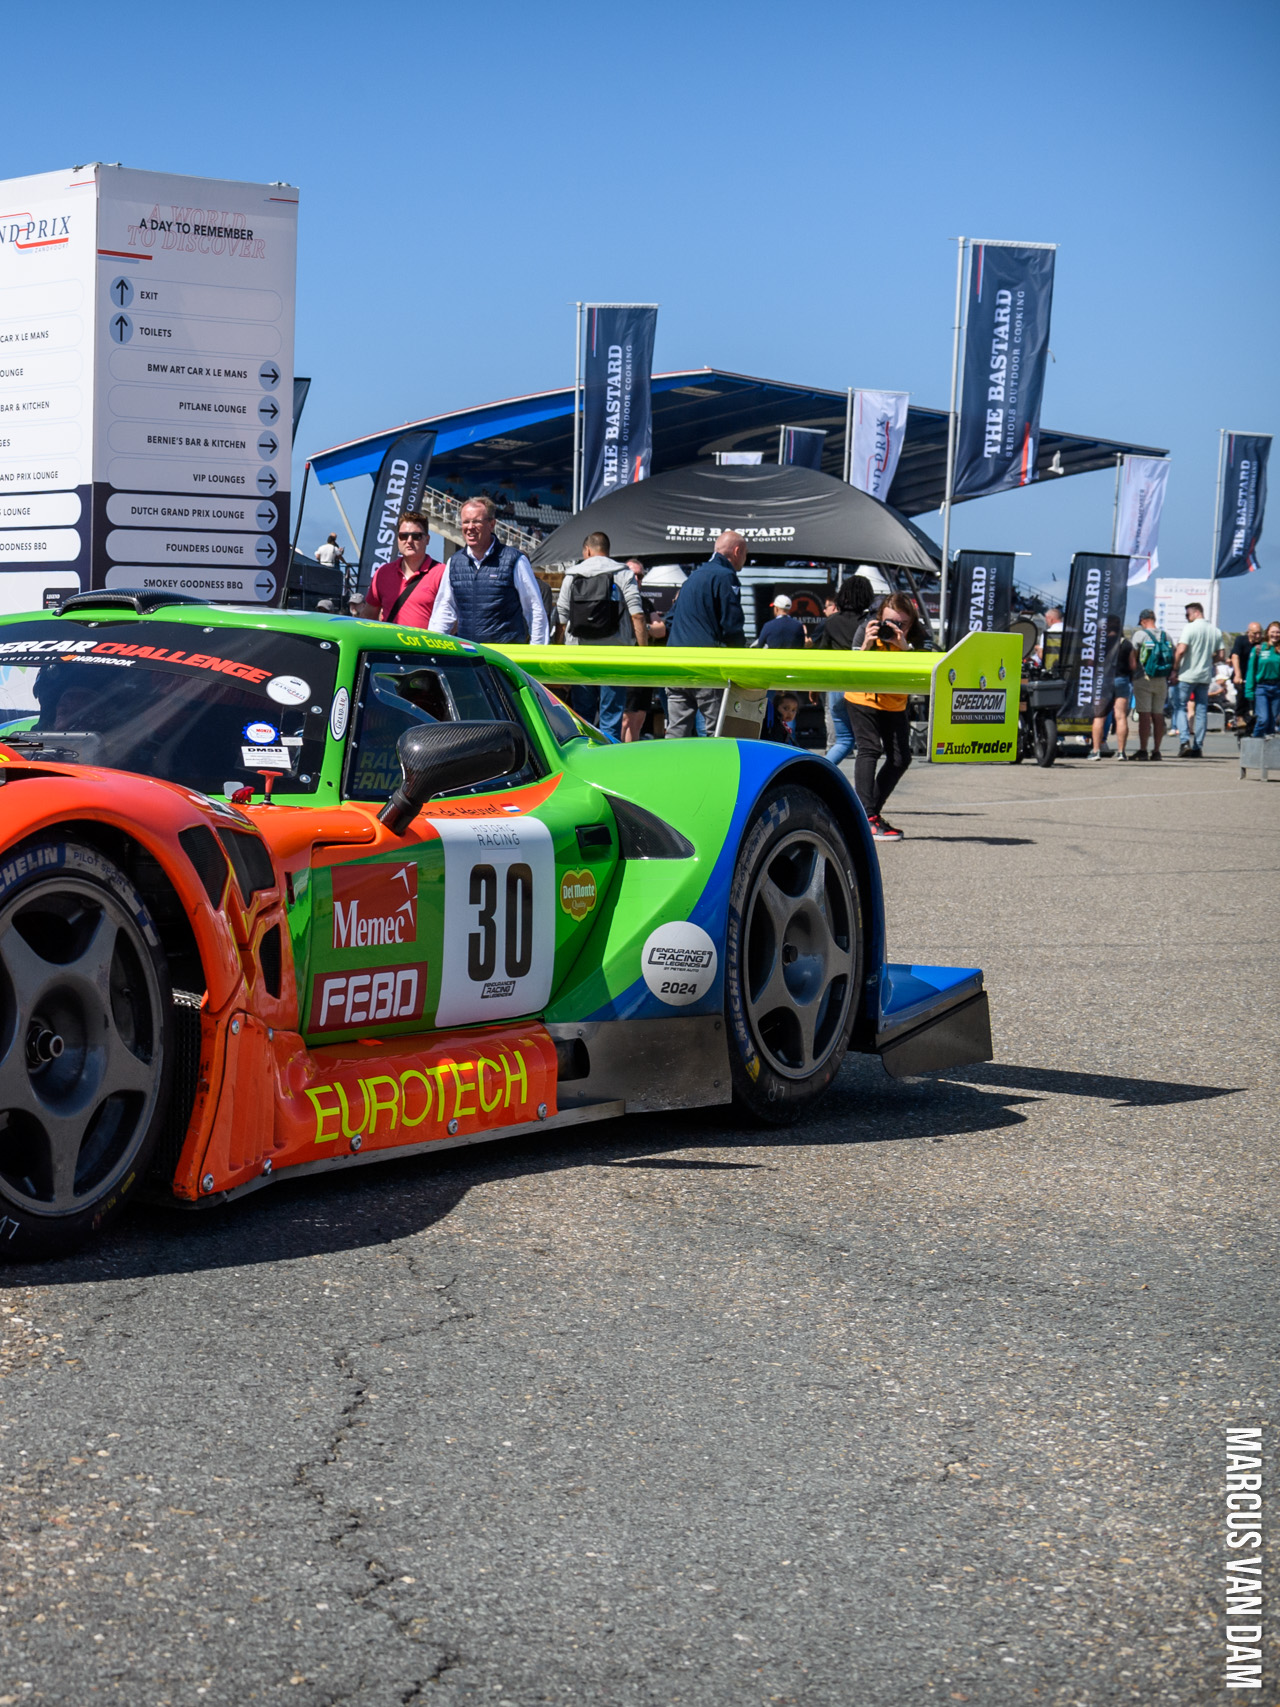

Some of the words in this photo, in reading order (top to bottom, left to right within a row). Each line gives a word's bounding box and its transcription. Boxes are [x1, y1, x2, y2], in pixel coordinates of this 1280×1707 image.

[25, 215, 71, 240] PRIX
[140, 218, 148, 230] A
[150, 219, 173, 232] DAY
[176, 222, 191, 234] TO
[193, 224, 254, 241] REMEMBER
[171, 206, 246, 230] WORLD
[161, 229, 266, 259] DISCOVER
[140, 290, 159, 301] EXIT
[1014, 291, 1026, 343] COOKING
[0, 334, 14, 344] CAR
[20, 332, 29, 342] LE
[29, 330, 49, 341] MANS
[139, 326, 172, 338] TOILETS
[988, 289, 1012, 401] BASTARD
[147, 363, 169, 374] BMW
[169, 365, 186, 375] ART
[186, 366, 204, 377] CAR
[212, 368, 222, 378] LE
[222, 369, 248, 379] MANS
[625, 345, 633, 391] COOKING
[1010, 348, 1020, 403] OUTDOOR
[606, 345, 622, 440] BASTARD
[0, 403, 14, 413] BAR
[22, 400, 50, 411] KITCHEN
[178, 401, 212, 413] PITLANE
[213, 404, 247, 414] LOUNGE
[623, 395, 631, 441] OUTDOOR
[185, 437, 202, 448] BAR
[211, 439, 246, 450] KITCHEN
[874, 419, 886, 462] PRIX
[984, 409, 1004, 458] THE
[1006, 409, 1017, 458] SERIOUS
[16, 472, 32, 482] PRIX
[32, 470, 59, 481] LOUNGE
[604, 444, 618, 486] THE
[621, 445, 629, 485] SERIOUS
[192, 473, 207, 483] VIP
[208, 474, 246, 485] LOUNGES
[406, 463, 422, 512] OOKING
[1235, 460, 1251, 526] BASTARD
[3, 507, 31, 517] LOUNGE
[130, 506, 159, 517] DUTCH
[160, 507, 190, 518] GRAND
[191, 508, 211, 519] PRIX
[212, 509, 245, 520] LOUNGE
[371, 459, 409, 578] BASTARD
[666, 525, 705, 536] THE
[33, 541, 47, 552] BBQ
[165, 543, 210, 554] FOUNDERS
[211, 544, 244, 555] LOUNGE
[1233, 529, 1245, 558] THE
[142, 578, 179, 589] SMOKEY
[179, 579, 225, 590] GOODNESS
[226, 580, 244, 591] BBQ
[1102, 570, 1111, 613] COOKING
[969, 566, 987, 632] STARD
[1081, 568, 1101, 661] BASTARD
[397, 633, 422, 646] Cor
[421, 635, 458, 651] Euser
[1099, 617, 1108, 663] OUTDOOR
[91, 641, 273, 684] CHALLENGE
[1078, 666, 1094, 707] THE
[954, 694, 1004, 711] SPEEDCOM
[951, 714, 1005, 722] COMMUNICATIONS
[943, 740, 1013, 755] AutoTrader
[471, 824, 515, 832] HISTORIC
[477, 834, 520, 846] RACING
[73, 851, 100, 867] PILOT
[563, 885, 574, 899] Del
[574, 884, 595, 898] Monte
[332, 900, 404, 948] Memec
[468, 862, 533, 981] 30
[658, 953, 704, 962] RACING
[660, 982, 697, 995] 2024
[728, 918, 748, 1043] MICHELIN
[319, 969, 418, 1027] FEBO
[304, 1051, 528, 1144] EUROTECH
